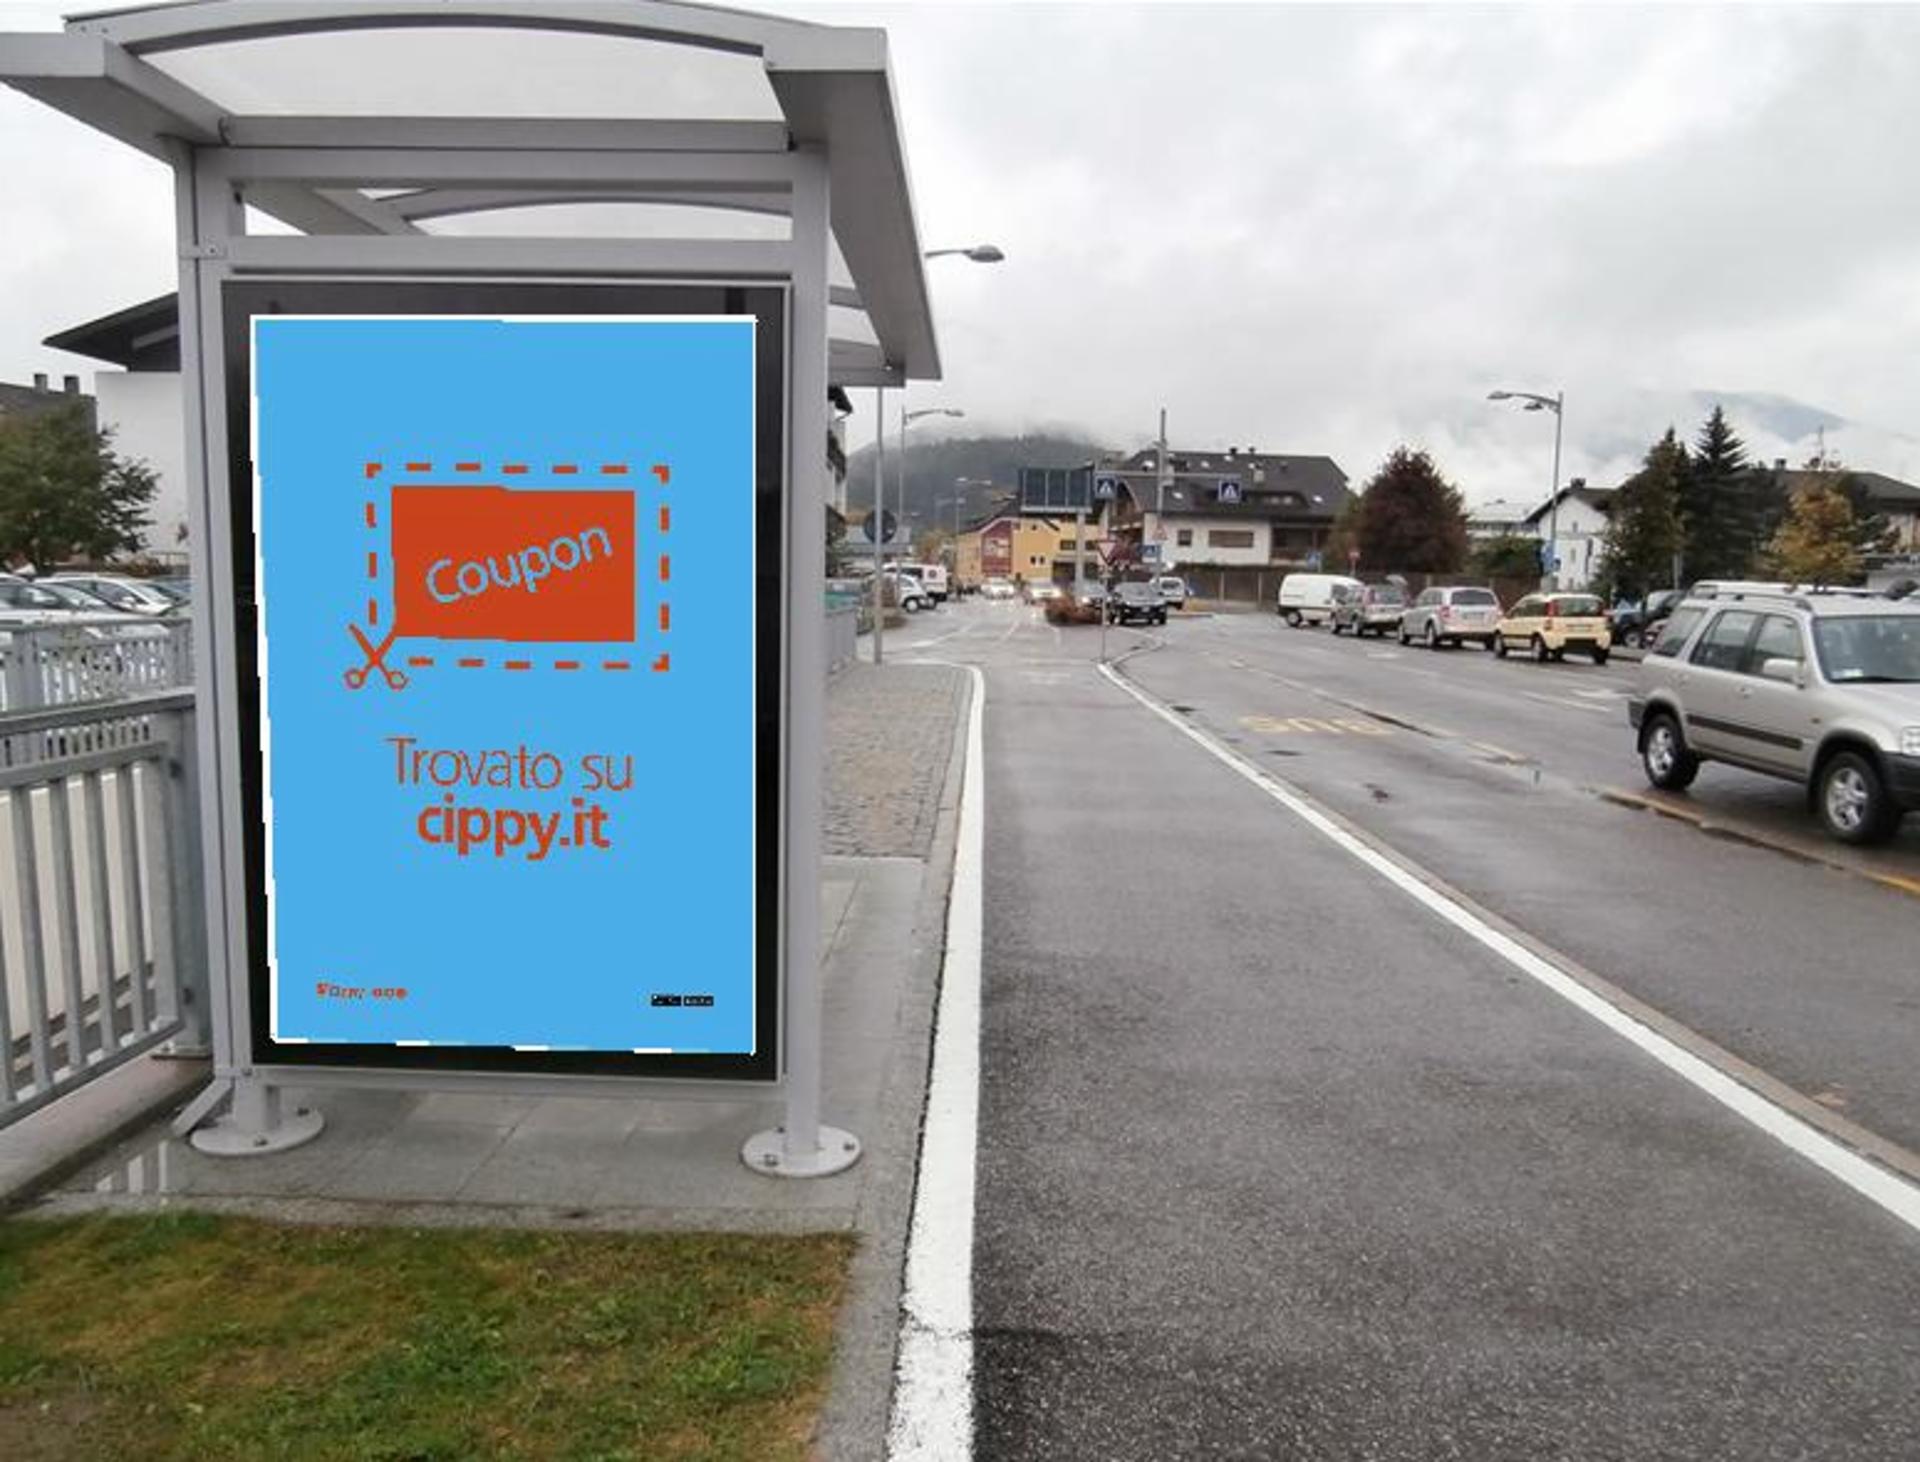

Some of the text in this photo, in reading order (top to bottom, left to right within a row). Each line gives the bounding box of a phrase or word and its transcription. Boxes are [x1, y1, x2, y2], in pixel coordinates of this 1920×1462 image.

[426, 526, 612, 604] Coupon
[386, 736, 635, 792] Trovato su
[416, 794, 611, 861] cippy.it
